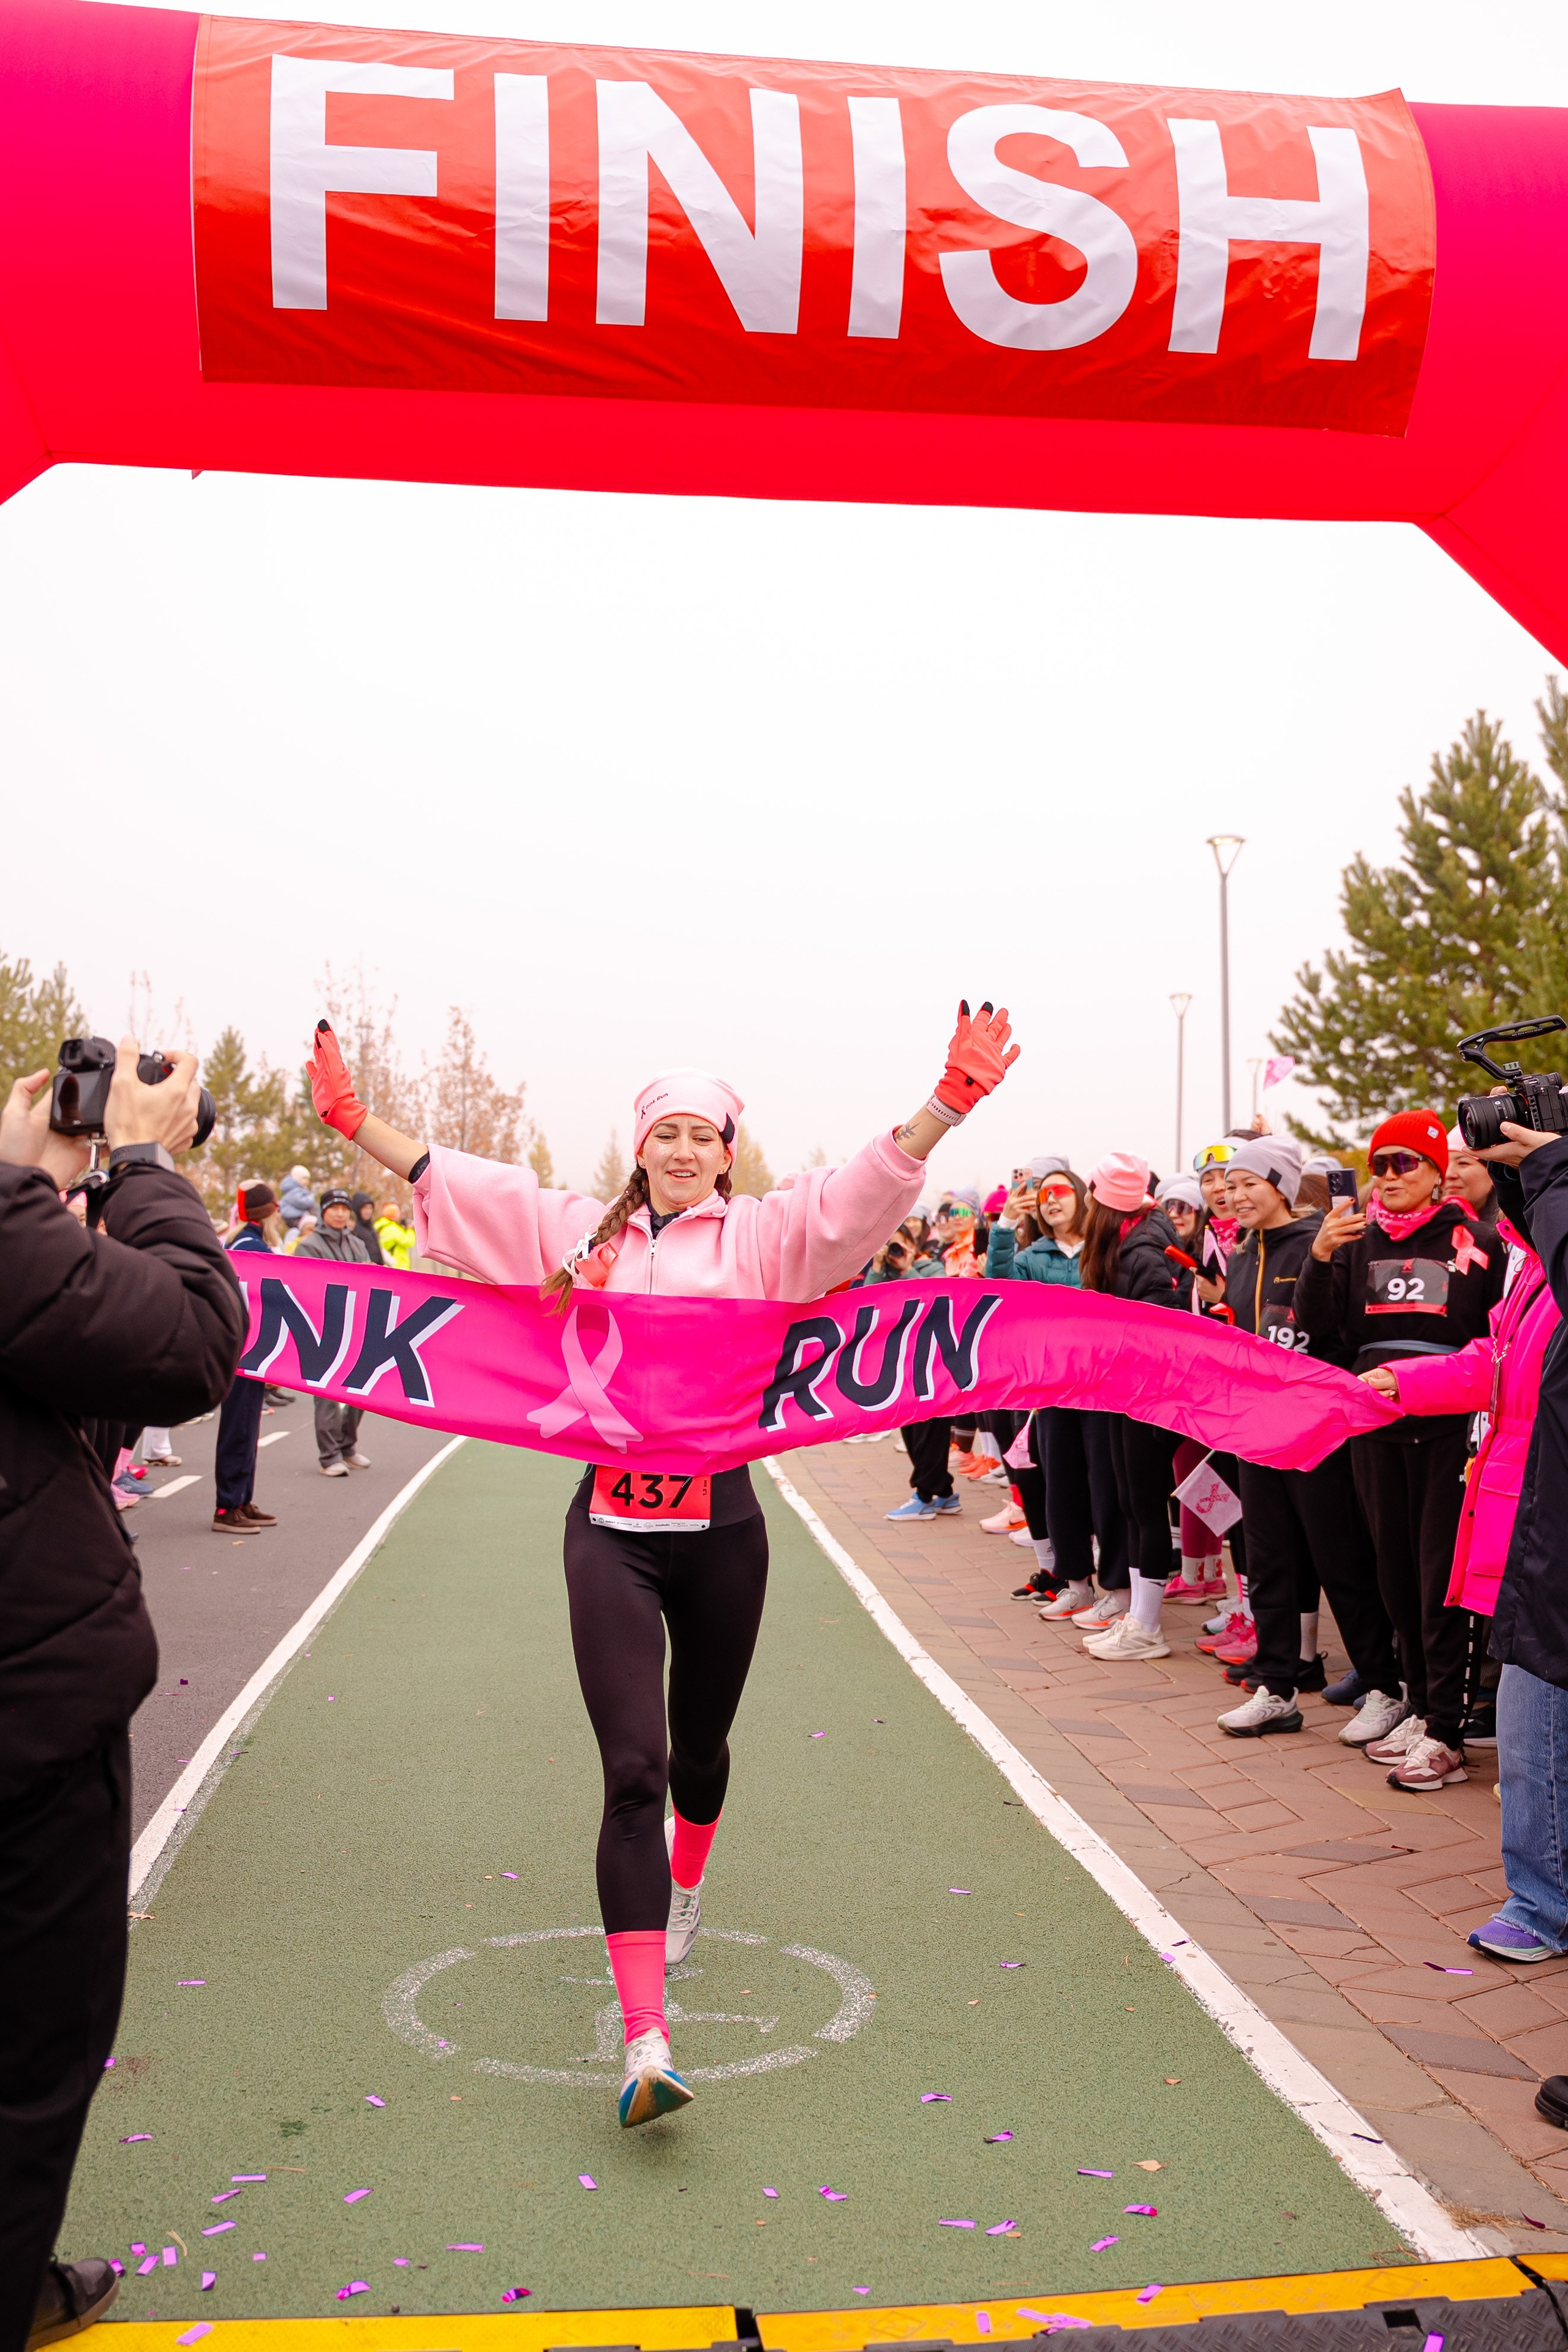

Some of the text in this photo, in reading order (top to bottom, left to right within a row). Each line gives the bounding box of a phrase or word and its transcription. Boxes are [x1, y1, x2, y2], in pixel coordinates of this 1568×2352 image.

[270, 53, 1370, 361] FINISH
[1387, 1277, 1425, 1300] 92
[236, 1277, 1003, 1432] NK RUN
[1268, 1325, 1310, 1354] 192
[611, 1472, 693, 1509] 437
